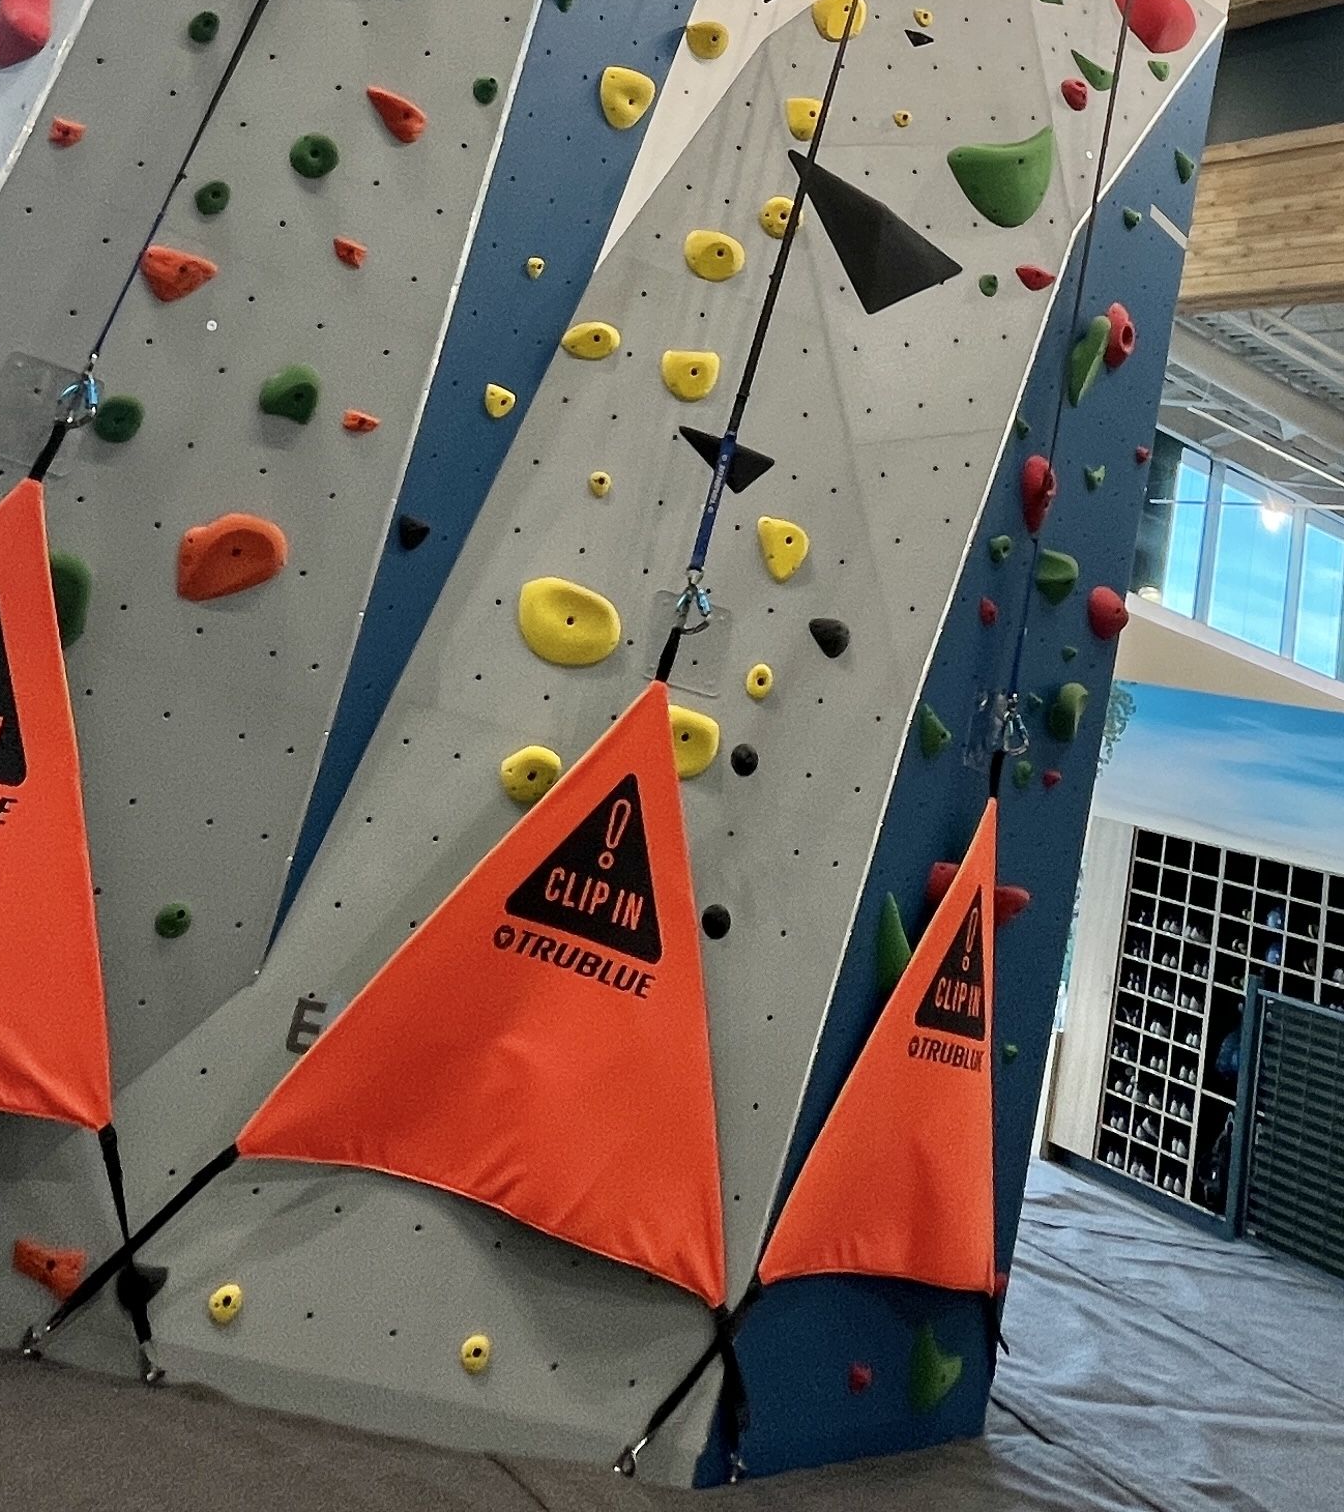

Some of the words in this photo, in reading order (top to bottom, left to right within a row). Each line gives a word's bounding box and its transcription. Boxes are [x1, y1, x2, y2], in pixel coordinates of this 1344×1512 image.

[544, 867, 609, 916] CLIP
[611, 889, 644, 930] IN
[514, 929, 657, 1000] TRUBLUE
[935, 977, 967, 1013] CLIP
[968, 986, 982, 1017] IN
[919, 1038, 985, 1073] TRUBLUE
